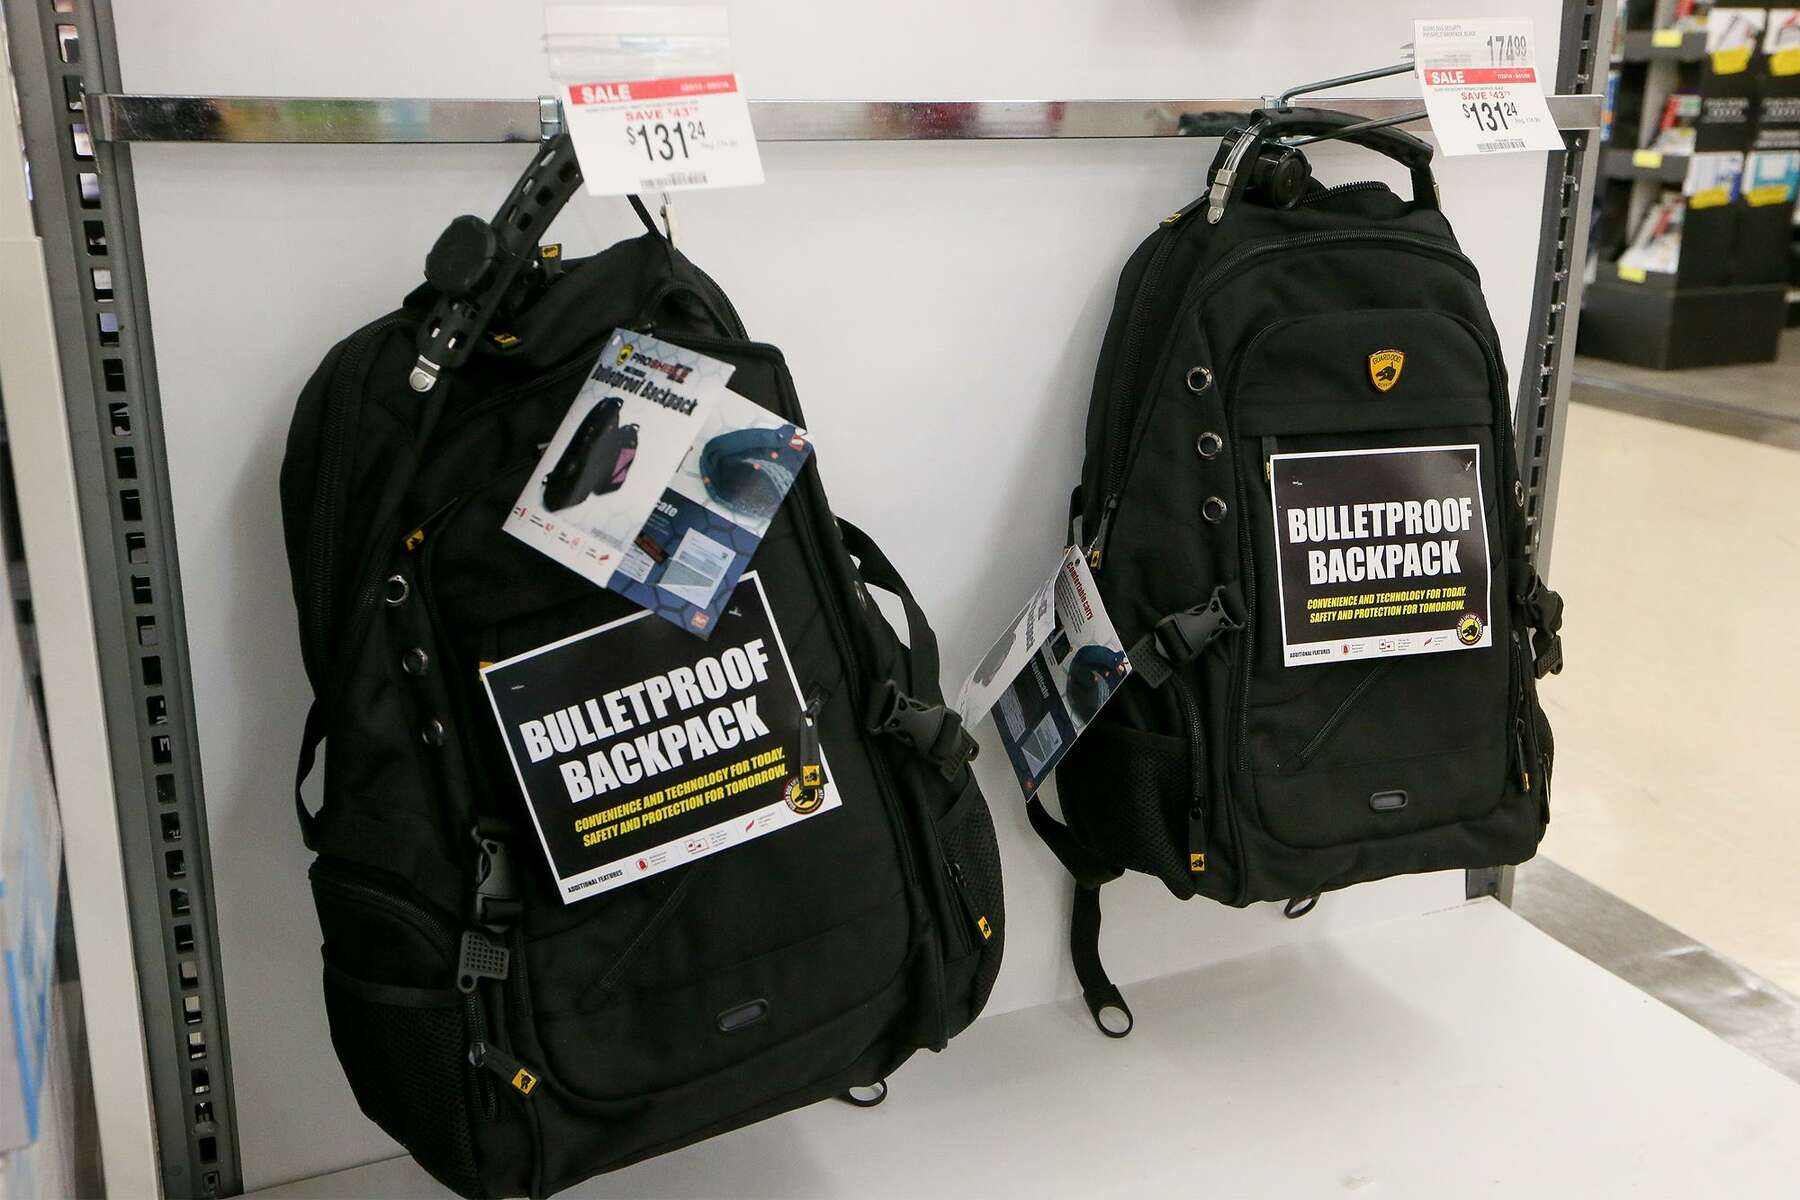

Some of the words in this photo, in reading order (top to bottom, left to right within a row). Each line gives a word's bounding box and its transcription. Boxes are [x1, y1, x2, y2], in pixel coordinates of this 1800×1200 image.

[1431, 71, 1465, 84] SALE
[581, 84, 631, 103] SALE
[1461, 92, 1488, 100] SAVE
[625, 109, 662, 121] SAVE
[640, 381, 699, 416] Backpack
[1287, 497, 1473, 544] BULLETPROOF
[1308, 540, 1461, 585] BACKPACK
[1066, 561, 1087, 603] Comfortable
[1082, 600, 1094, 621] carry
[1307, 595, 1358, 610] CONVENIENCE
[1358, 594, 1374, 605] AND
[1376, 590, 1426, 604] TECHNOLOGY
[1426, 588, 1441, 600] FOR
[1442, 586, 1467, 598] TODAY.
[1310, 611, 1337, 624] SAFETY
[1337, 609, 1353, 621] AND
[1354, 605, 1402, 619] PROTECTION
[1402, 604, 1418, 615] FOR
[1419, 600, 1465, 614] TOMORROW.
[1289, 650, 1312, 658] ADDITIONAL
[1312, 648, 1331, 656] FEATURES
[519, 638, 769, 764] BULLETPROOF
[560, 696, 770, 803] BACKPACK
[575, 799, 642, 833] CONVENIENCE
[643, 789, 664, 809] AND
[665, 767, 730, 802] TECHNOLOGY
[730, 759, 750, 780] FOR
[750, 747, 785, 769] TODAY.
[583, 825, 619, 847] SAFETY
[620, 816, 641, 836] AND
[642, 794, 704, 828] PROTECTION
[705, 784, 725, 804] FOR
[725, 763, 788, 797] TOMORROW.
[567, 878, 598, 893] ADDITIONAL
[598, 870, 624, 883] FEATURES
